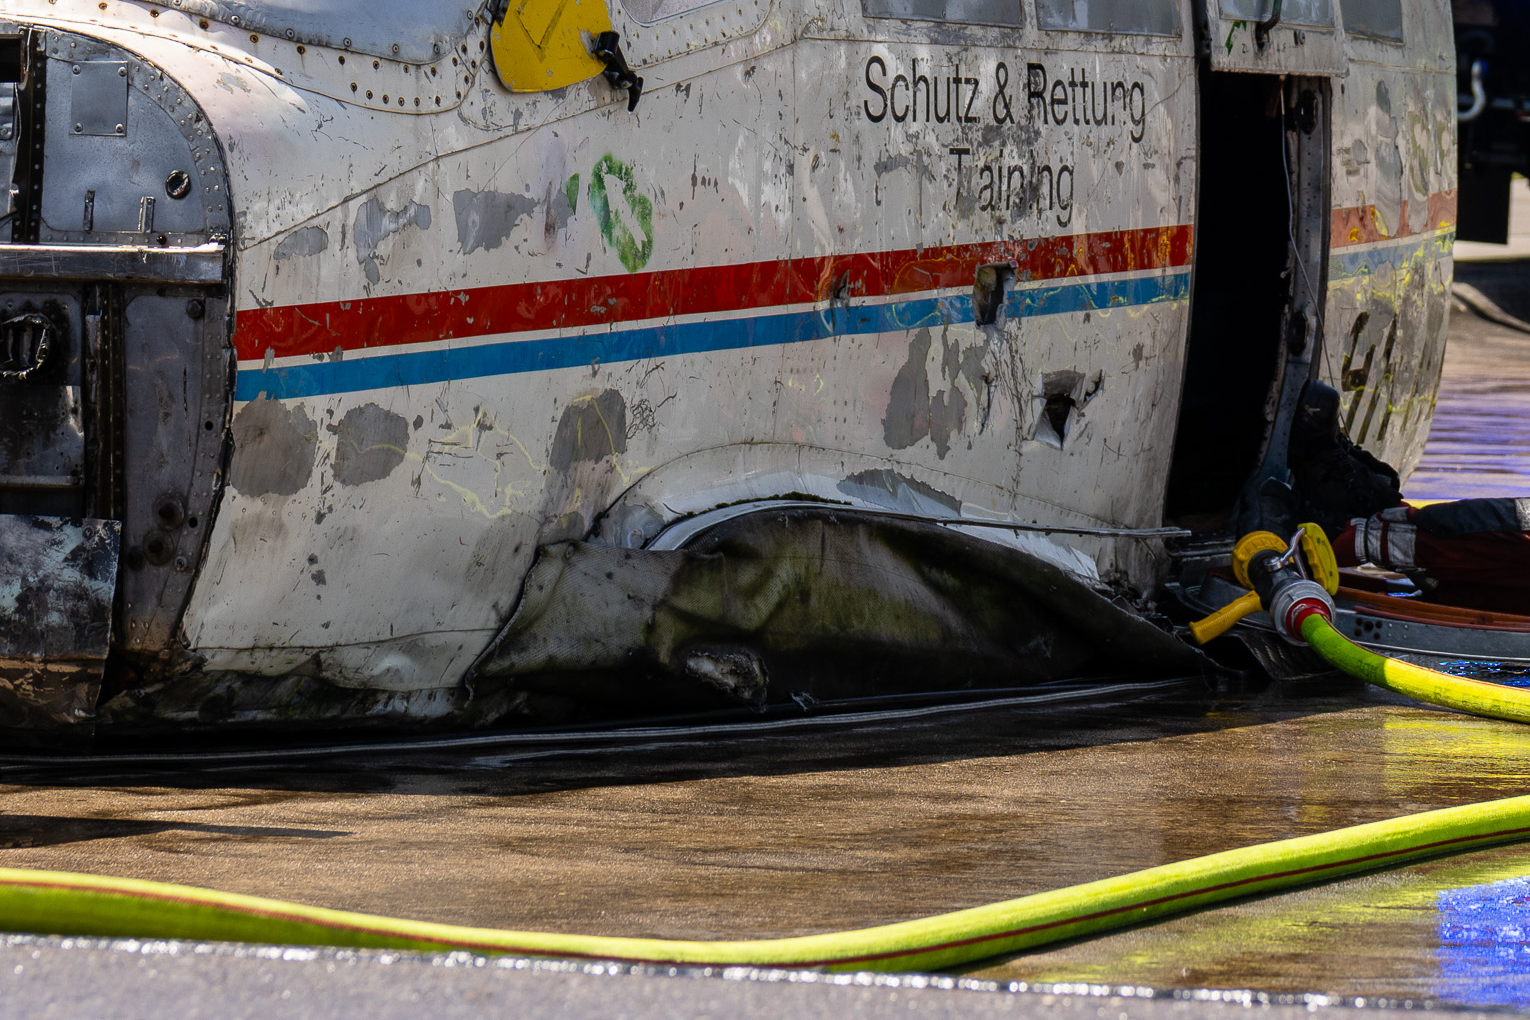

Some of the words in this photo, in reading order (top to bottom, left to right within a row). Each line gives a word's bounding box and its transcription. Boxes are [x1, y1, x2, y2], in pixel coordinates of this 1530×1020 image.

[863, 55, 980, 123] Schutz
[992, 61, 1015, 125] &
[1026, 61, 1147, 143] Rettung
[948, 147, 1075, 228] Taining
